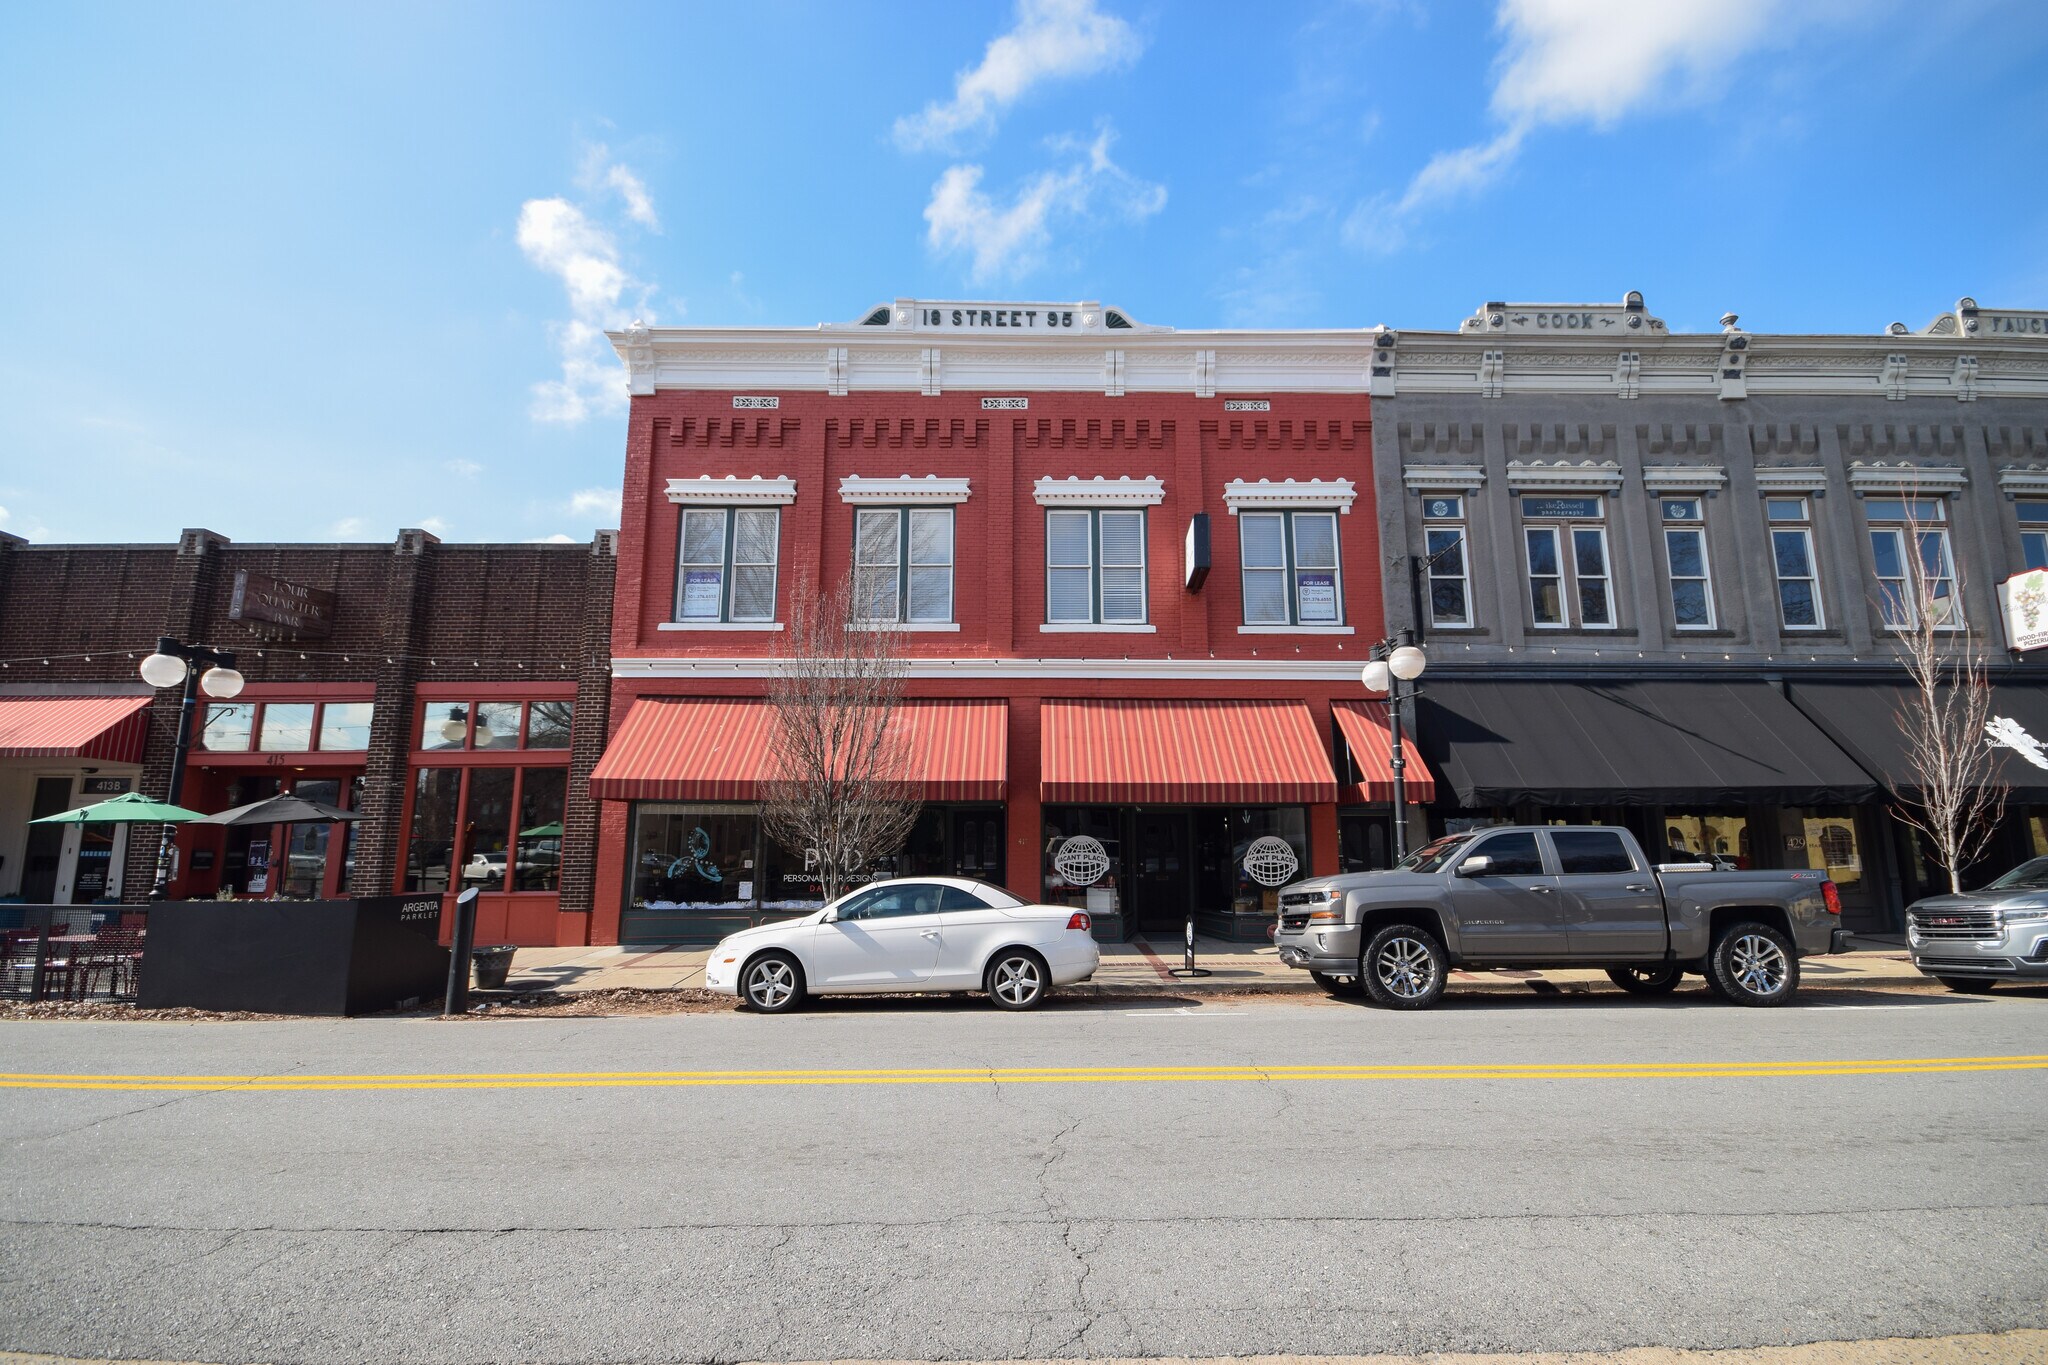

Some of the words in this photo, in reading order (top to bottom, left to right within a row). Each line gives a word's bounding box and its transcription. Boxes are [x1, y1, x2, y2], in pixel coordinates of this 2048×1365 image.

[923, 309, 941, 326] 18
[952, 310, 1037, 327] STREET
[1047, 311, 1073, 328] 95
[1536, 313, 1593, 329] COOK
[266, 755, 285, 765] 415
[97, 781, 121, 791] 413B
[1787, 837, 1806, 849] 429
[1083, 854, 1107, 864] PLACES
[1271, 855, 1296, 864] PLACES
[402, 901, 439, 913] ARGENTA
[401, 911, 439, 921] PARKLET
